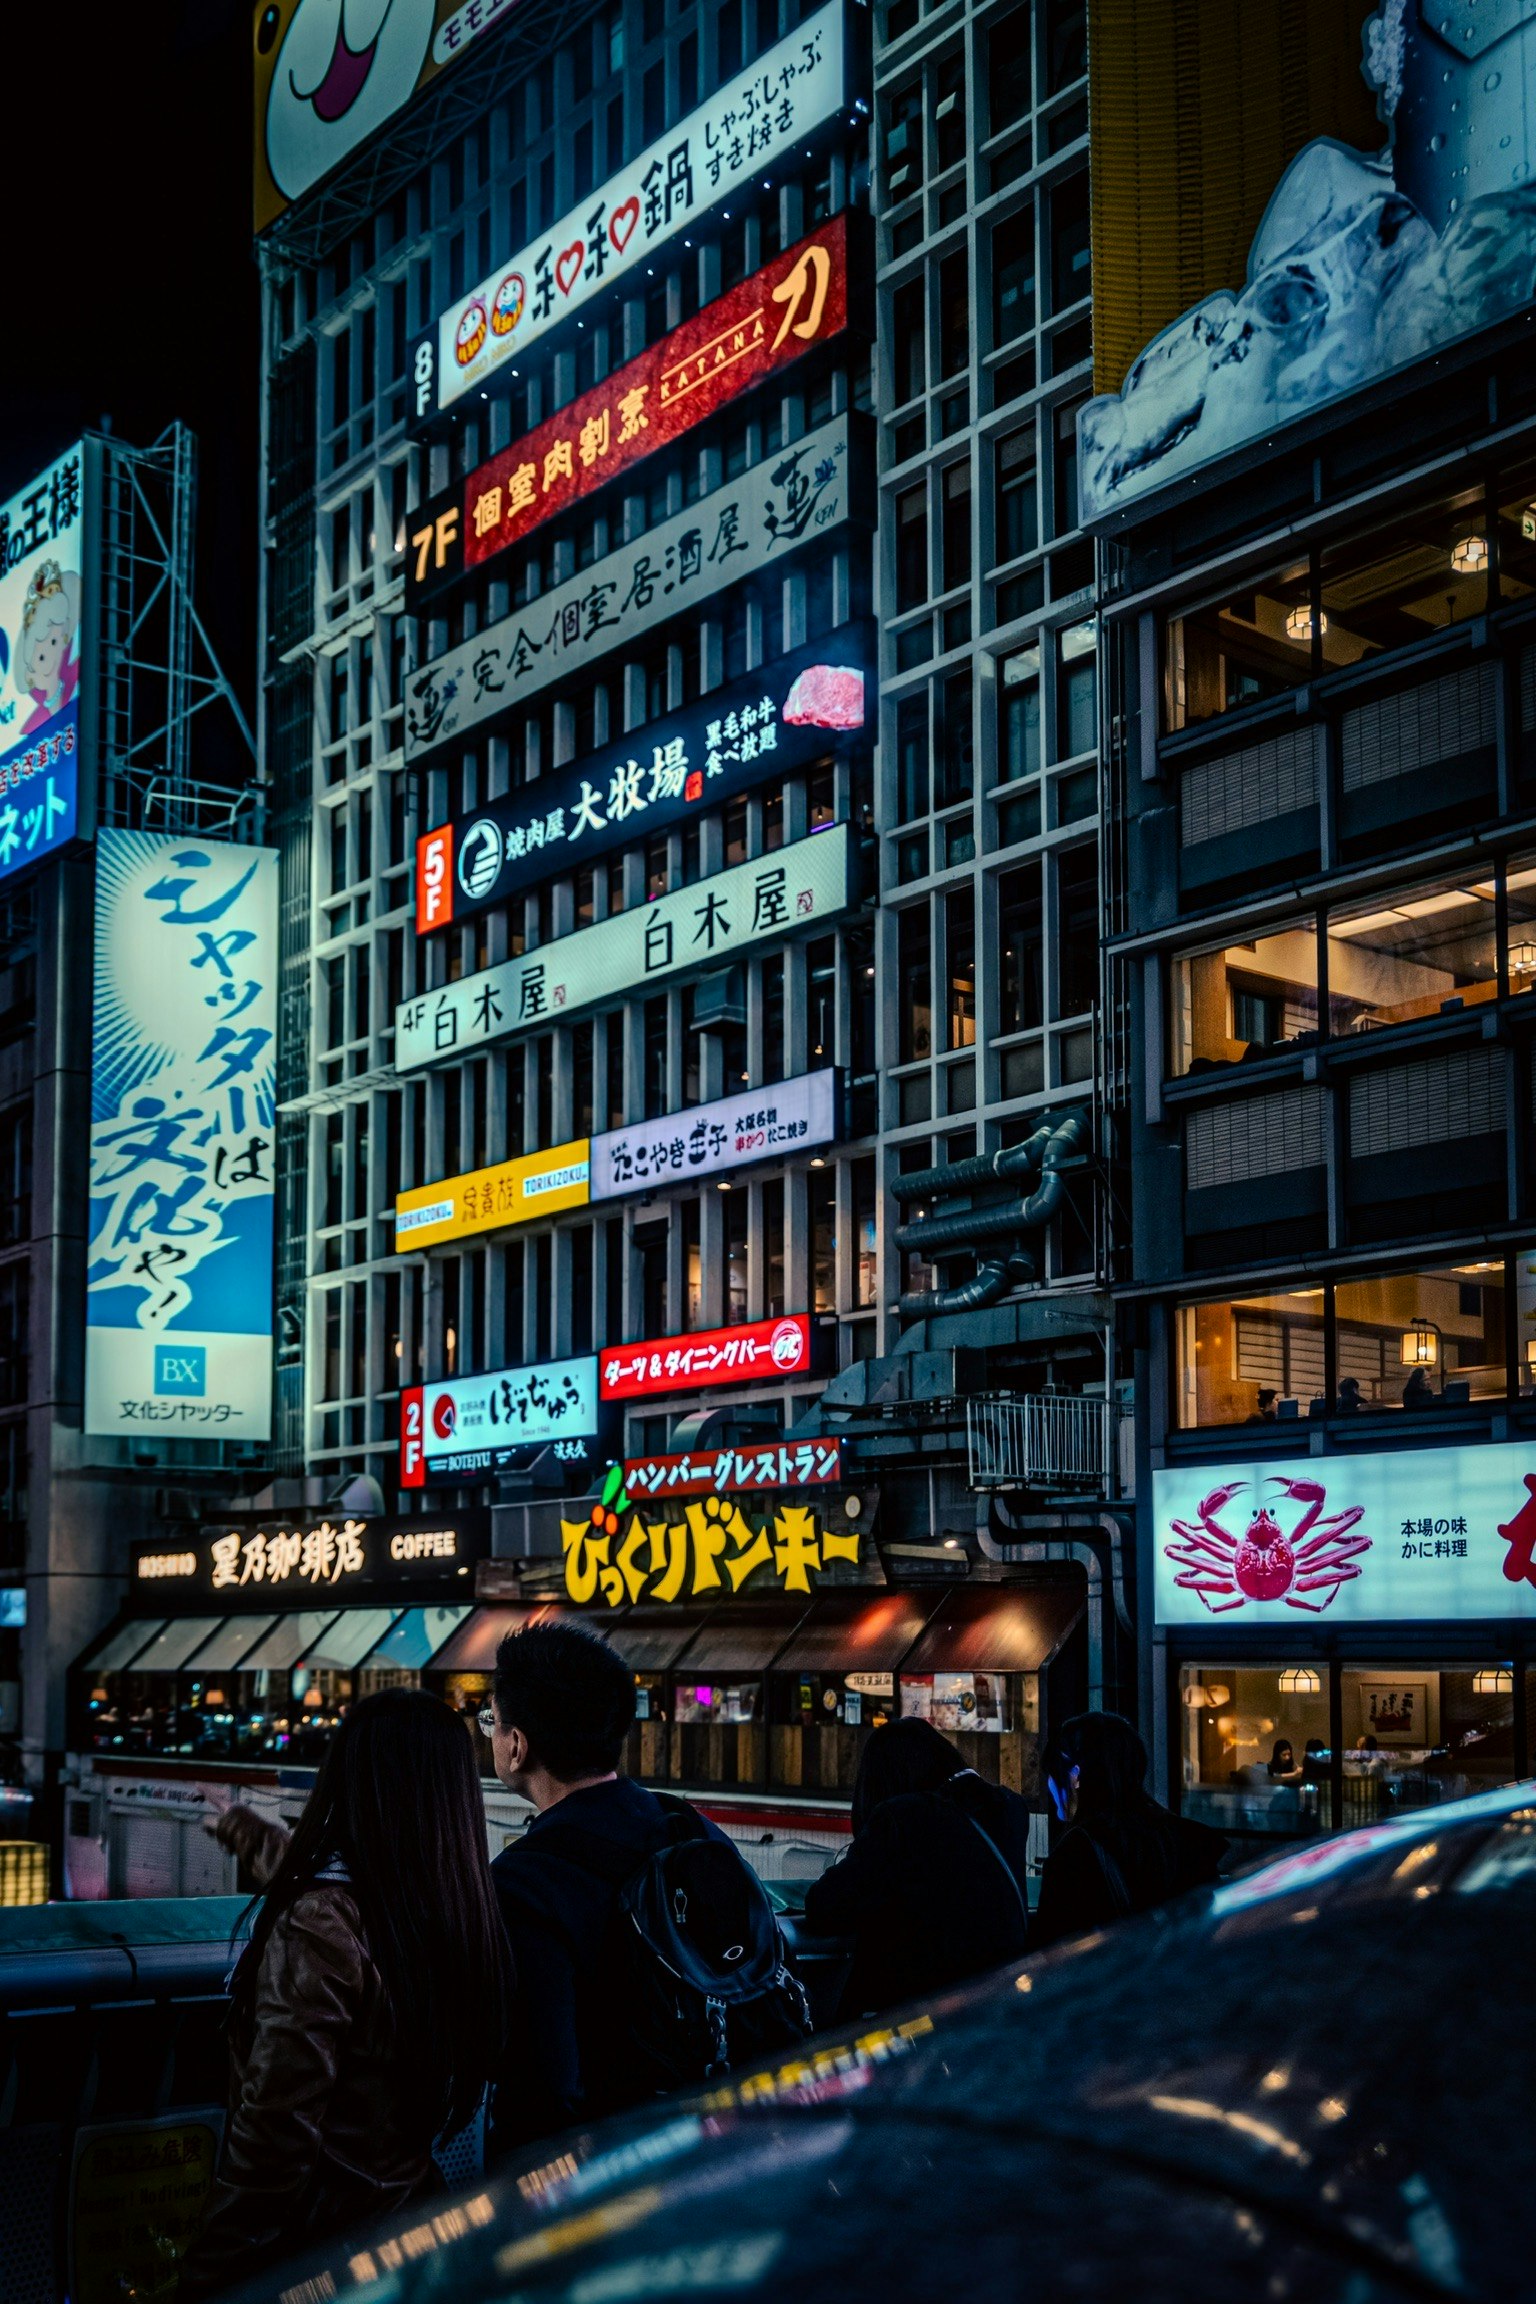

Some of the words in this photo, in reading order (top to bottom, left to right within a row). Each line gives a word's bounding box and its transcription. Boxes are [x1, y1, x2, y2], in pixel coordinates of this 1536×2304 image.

[705, 29, 823, 147] しゃぶしゃぶ
[705, 98, 795, 187] すき焼き
[770, 245, 831, 354] 刀
[414, 341, 433, 417] 8F
[660, 323, 765, 402] KATANA
[472, 385, 650, 540] 個室肉割烹
[412, 507, 459, 583] 7F
[473, 502, 749, 703] 完全個室居酒屋
[706, 697, 785, 757] 黒毛和牛
[706, 726, 785, 787] 食べ放題
[505, 807, 567, 861] 焼肉屋
[568, 735, 690, 842] 大牧場
[424, 838, 446, 921] 5F
[644, 867, 790, 973] 白木屋
[144, 850, 274, 1190] シャッターは
[402, 1003, 427, 1034] 4F
[434, 964, 548, 1052] 白木屋
[735, 1107, 778, 1134] 大阪名物
[735, 1131, 765, 1153] 串かつ
[768, 1120, 808, 1144] たこ焼き
[523, 1167, 582, 1194] TORIKIZOKU
[161, 1358, 198, 1384] BX
[490, 1375, 580, 1424] ぼてぢゅう
[118, 1400, 244, 1424] 文化シャッター
[405, 1401, 421, 1474] 2F
[626, 1445, 839, 1494] ハンバーグレストラン
[210, 1520, 367, 1588] 星乃珈琲店
[390, 1530, 457, 1561] COFFEE
[561, 1496, 860, 1606] びっくりドンキー
[1400, 1516, 1468, 1537] 本場の味
[1400, 1540, 1468, 1560] かに料理
